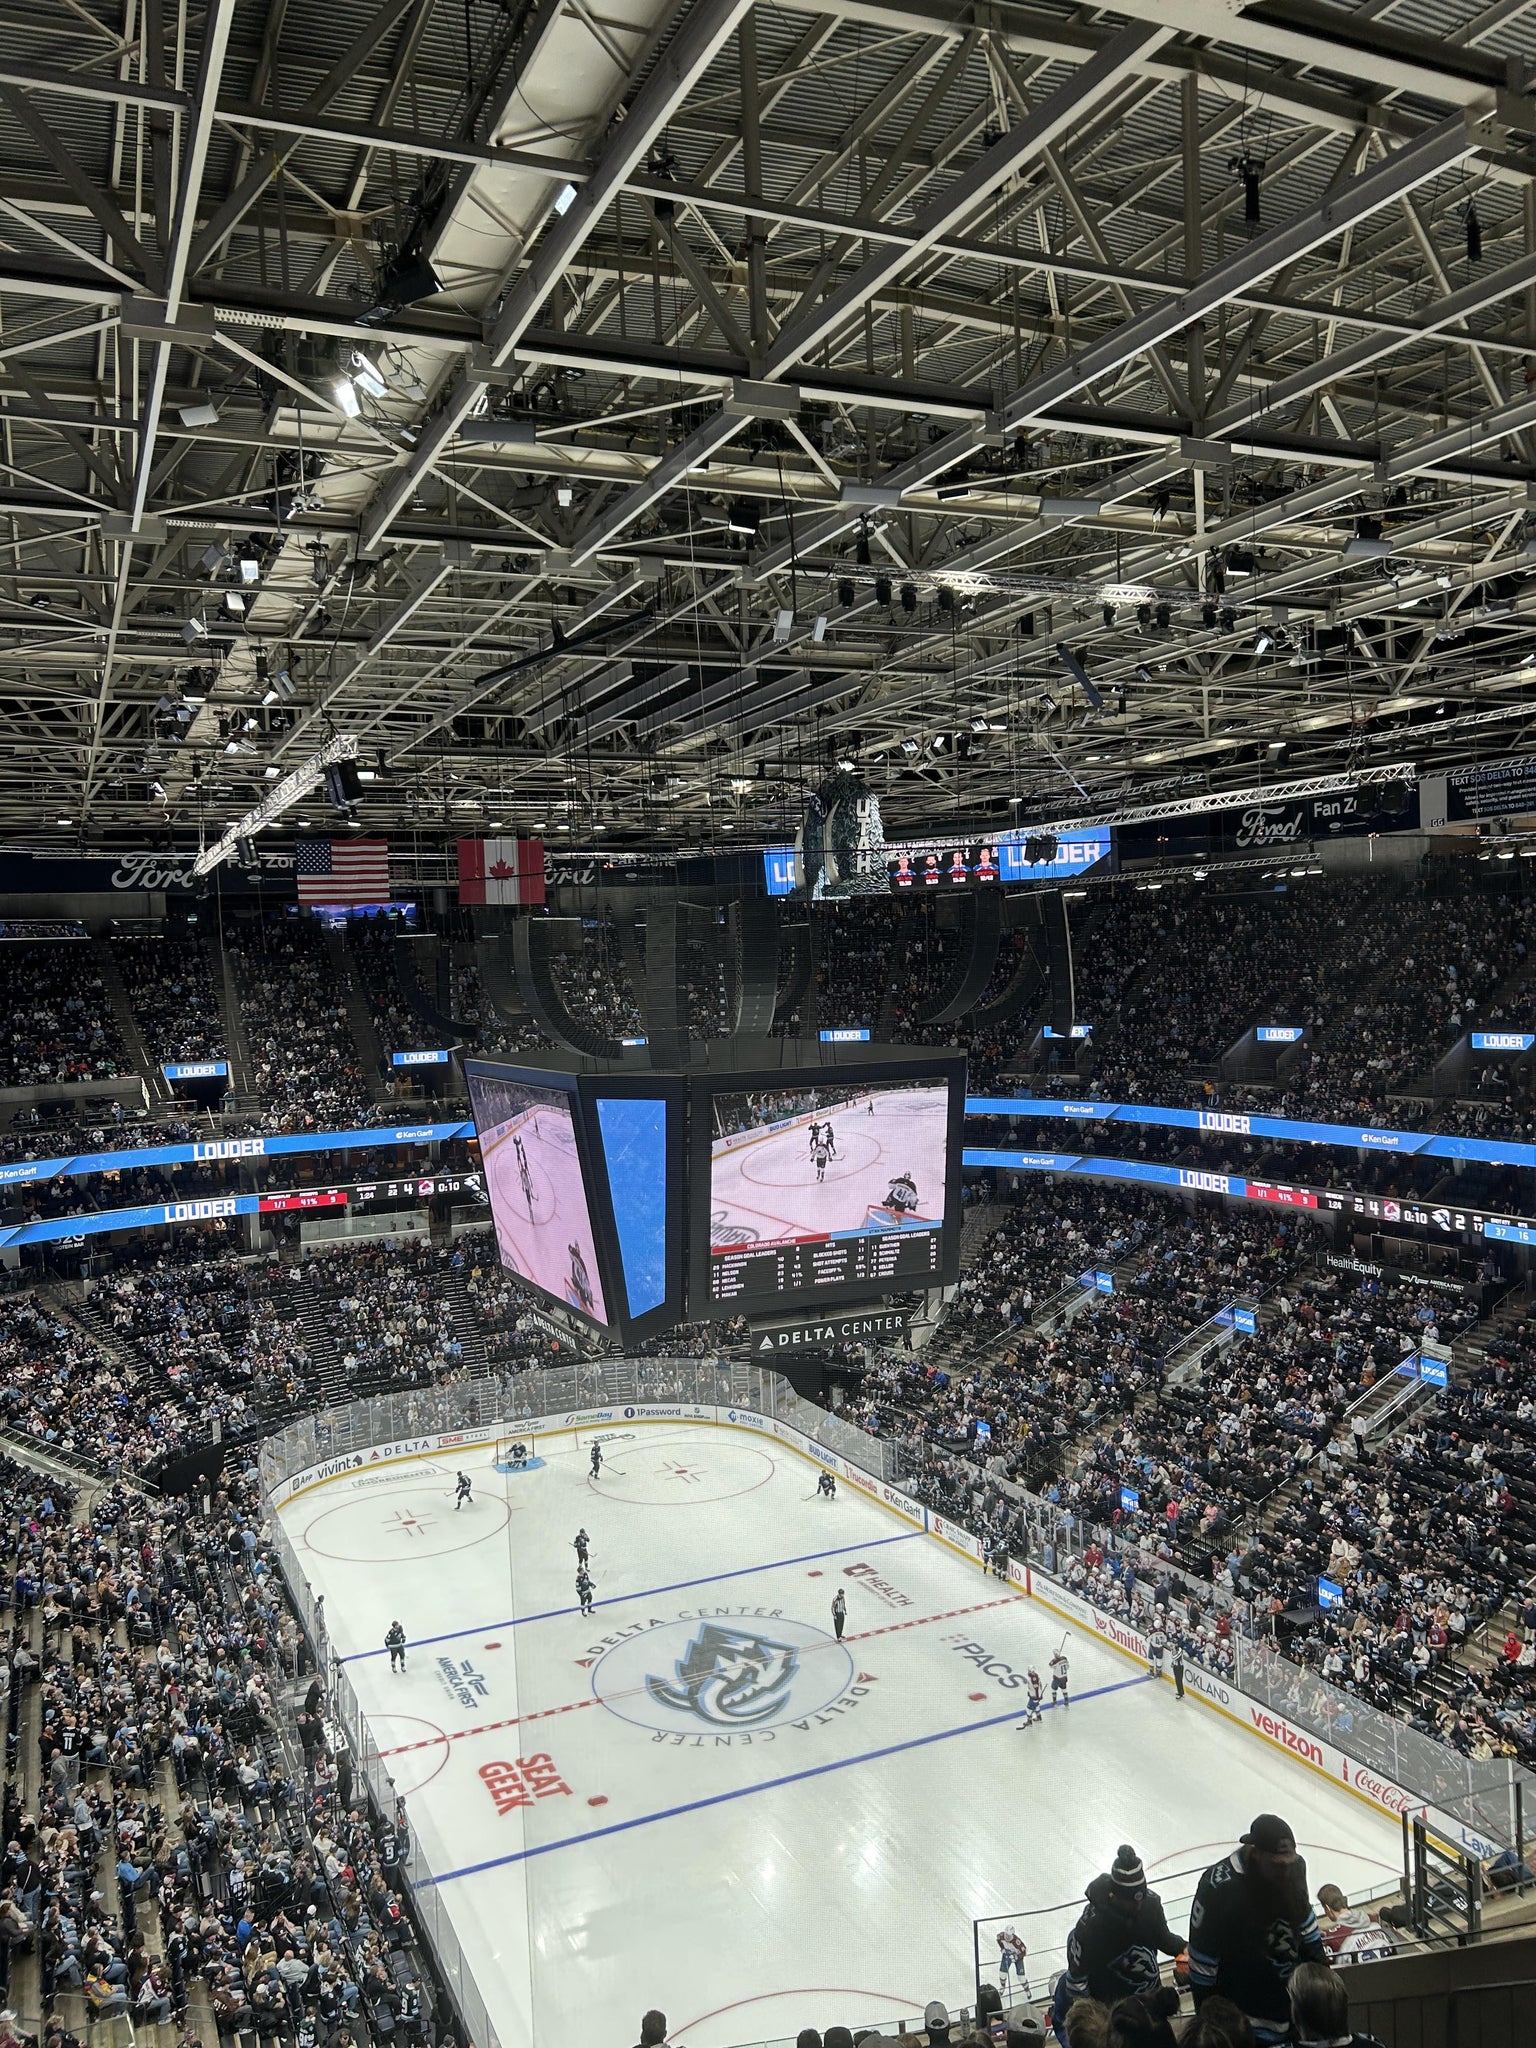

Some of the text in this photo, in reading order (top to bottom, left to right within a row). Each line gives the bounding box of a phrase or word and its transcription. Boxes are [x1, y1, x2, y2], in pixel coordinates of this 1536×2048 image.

[1450, 776, 1470, 786] TEXT
[1487, 769, 1511, 781] DELTA
[1511, 768, 1523, 777] TO
[1314, 801, 1341, 818] Fan
[1235, 806, 1304, 847] Ford
[1432, 818, 1444, 827] GG
[856, 799, 871, 874] UTAH
[1008, 842, 1100, 868] LDER
[544, 860, 595, 885] ord
[829, 1031, 861, 1041] LOUDER
[1265, 1029, 1295, 1040] LOUDER
[1483, 1035, 1523, 1049] LOUDER
[403, 1052, 439, 1063] LOUDER
[177, 1065, 217, 1077] LOUDER
[1199, 1112, 1251, 1135] LOUDER
[193, 1138, 265, 1161] LOUDER
[1368, 1134, 1399, 1145] Ken Garff
[4, 1166, 37, 1178] Ken Garff
[1179, 1169, 1229, 1194] LOUDER
[403, 1183, 414, 1195] 4
[438, 1181, 460, 1192] 0:10
[1257, 1189, 1267, 1198] 1/1
[1278, 1192, 1293, 1202] 41%
[164, 1199, 237, 1223] LOUDER
[1353, 1203, 1364, 1213] 22
[1369, 1201, 1379, 1216] 4
[1404, 1209, 1428, 1225] 0:10
[1454, 1214, 1466, 1230] 2
[1473, 1222, 1484, 1233] 17
[1495, 1227, 1506, 1237] 37
[1518, 1230, 1529, 1241] 16
[746, 1238, 797, 1250] COLORADO AVALANCHE
[882, 1234, 899, 1242] SEASON
[911, 1231, 930, 1239] LEADERS
[724, 1253, 744, 1262] SEASON
[756, 1249, 777, 1258] LEADERS
[1326, 1255, 1383, 1278] HealthEquity
[537, 1316, 577, 1350] DELTA CENTER
[778, 1316, 903, 1346] DELTA CENTER
[636, 1408, 681, 1417] 1Password
[739, 1413, 764, 1425] moxie
[441, 1431, 489, 1445] SME STEEL
[508, 1426, 530, 1435] AMERICA
[384, 1440, 430, 1457] DELTA
[809, 1443, 838, 1468] BUD LIGHT
[844, 1462, 878, 1494] Trucordia
[889, 1491, 921, 1520] Ken Garff
[866, 1576, 915, 1607] HEALTH
[678, 1606, 783, 1619] CENTER
[586, 1618, 666, 1655] DELTA
[1109, 1620, 1148, 1659] Smith's
[952, 1642, 1028, 1690] PACS
[436, 1656, 479, 1710] AMERICA FIRST
[1184, 1668, 1230, 1705] OKLAND
[791, 1685, 870, 1732] DELTA
[64, 1737, 73, 1750] 11
[651, 1730, 776, 1748] CENTER
[1251, 1707, 1324, 1767] verizon
[515, 1752, 574, 1799] SEAT
[478, 1761, 535, 1817] GEEK
[385, 1846, 395, 1860] 9
[400, 1997, 408, 2015] 9
